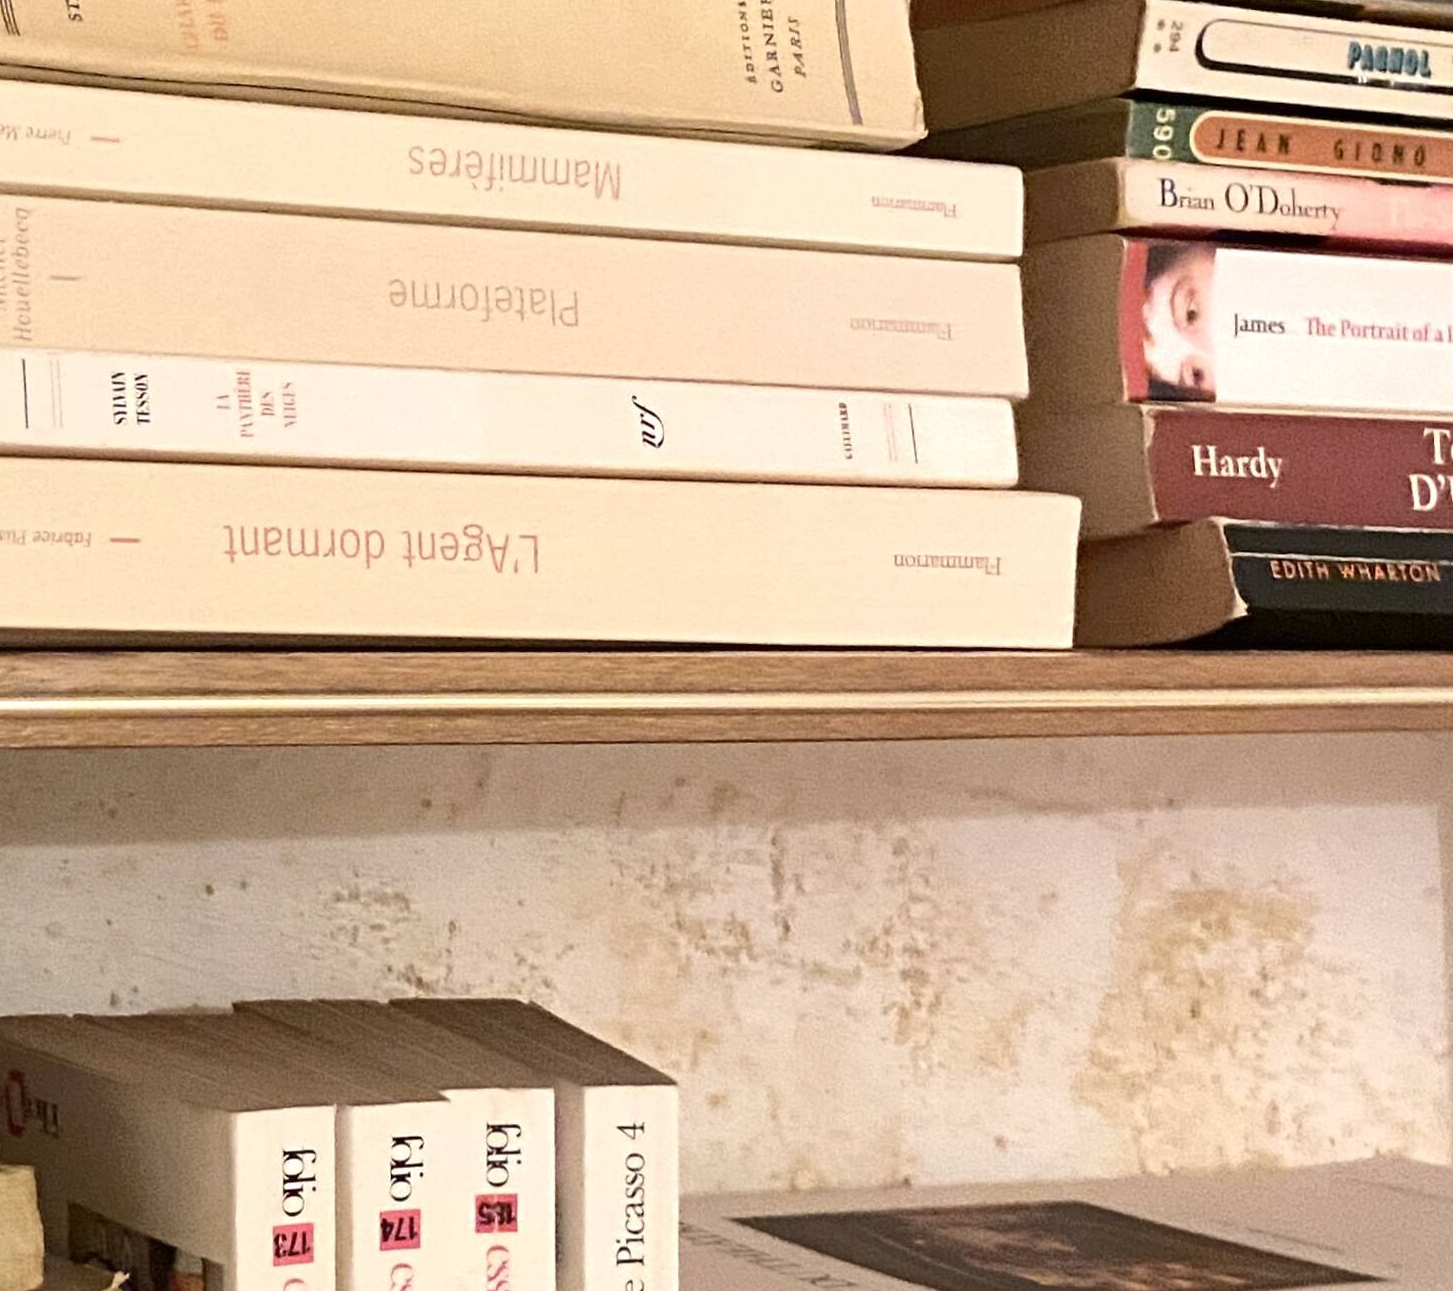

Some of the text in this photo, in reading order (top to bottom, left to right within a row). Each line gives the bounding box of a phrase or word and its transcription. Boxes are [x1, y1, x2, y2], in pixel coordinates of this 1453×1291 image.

[788, 15, 807, 79] PARIS
[24, 125, 72, 146] Pierre
[1152, 108, 1176, 160] 590
[1215, 128, 1427, 168] JEAN GIONO
[408, 144, 622, 202] Mammifères
[1158, 177, 1342, 231] Brian O'Doherty
[11, 207, 34, 342] Houellebecq
[388, 278, 580, 329] Plateforme
[849, 315, 954, 342] Flammarion
[1234, 312, 1286, 338] James
[1306, 316, 1335, 337] The
[1340, 319, 1409, 342] Portrait
[1412, 320, 1431, 343] of
[111, 371, 129, 426] SYLVAIN
[134, 372, 152, 426] TESSON
[1191, 444, 1284, 489] Hardy
[223, 523, 540, 576] L'Agent dormant
[893, 553, 1002, 577] Flammarion
[1270, 560, 1443, 582] EDITH WHARTON
[486, 1121, 522, 1189] folio
[617, 1121, 646, 1141] 4
[282, 1148, 318, 1219] folio
[390, 1135, 425, 1203] folio
[380, 1214, 419, 1244] 174
[616, 1151, 646, 1268] Picasso
[274, 1228, 313, 1258] 173
